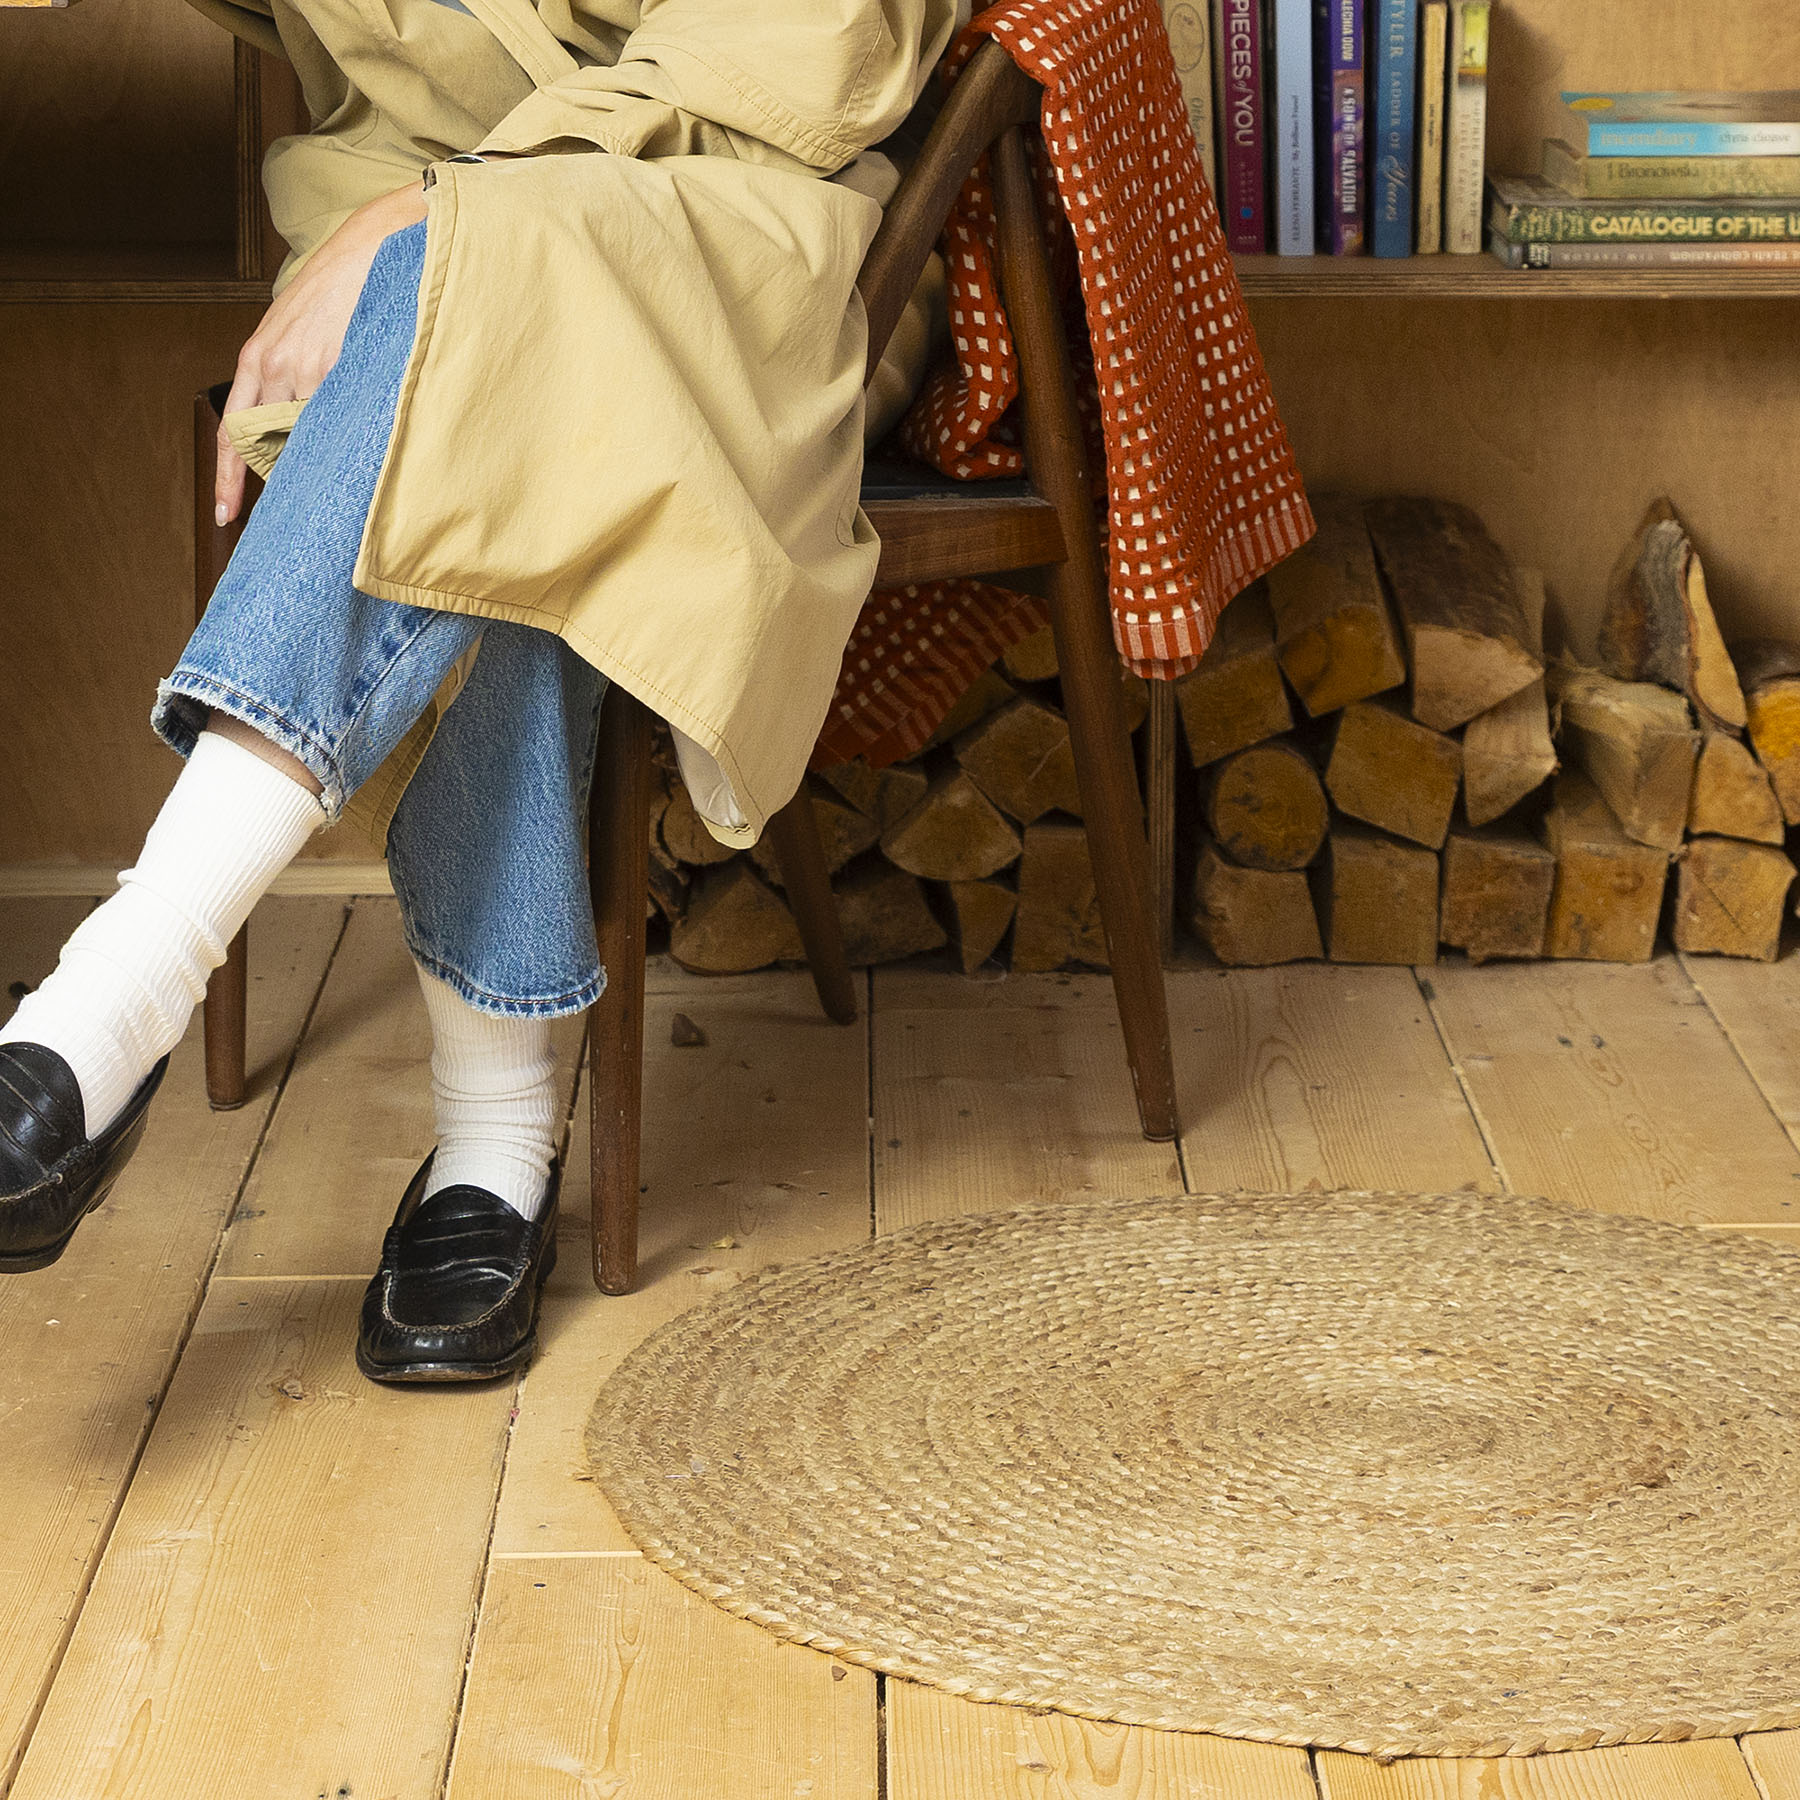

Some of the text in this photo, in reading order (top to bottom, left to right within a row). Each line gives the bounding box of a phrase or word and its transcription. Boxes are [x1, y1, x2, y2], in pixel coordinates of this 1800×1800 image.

[1233, 93, 1255, 148] YOU
[1341, 95, 1356, 131] SONG
[1390, 70, 1402, 128] LADDER
[1390, 130, 1401, 150] OF
[1341, 149, 1356, 213] SALVATION
[1590, 215, 1713, 237] CATALOGUE
[1716, 215, 1746, 237] OF
[1747, 215, 1785, 237] THE
